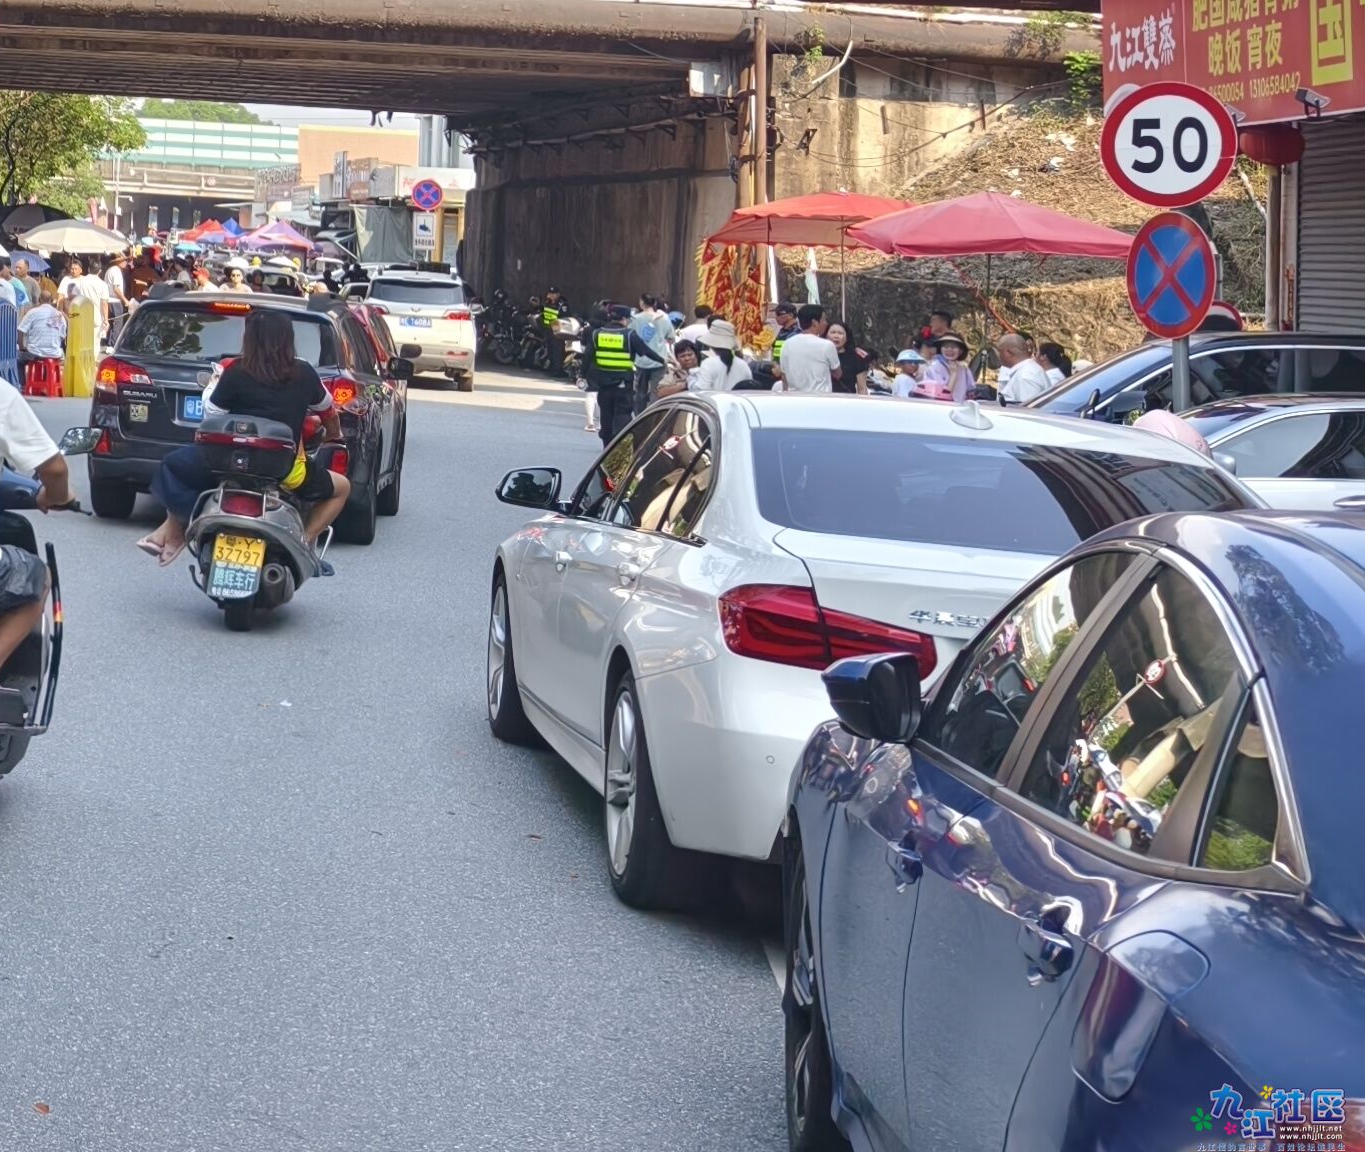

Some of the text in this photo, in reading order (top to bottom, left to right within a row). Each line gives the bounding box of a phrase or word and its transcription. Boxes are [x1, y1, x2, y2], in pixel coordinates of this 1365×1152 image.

[1108, 9, 1176, 73] 九江雙蒸
[1208, 20, 1283, 76] 晚饭 宵夜
[1131, 116, 1209, 173] 50
[122, 390, 158, 399] SUBARU
